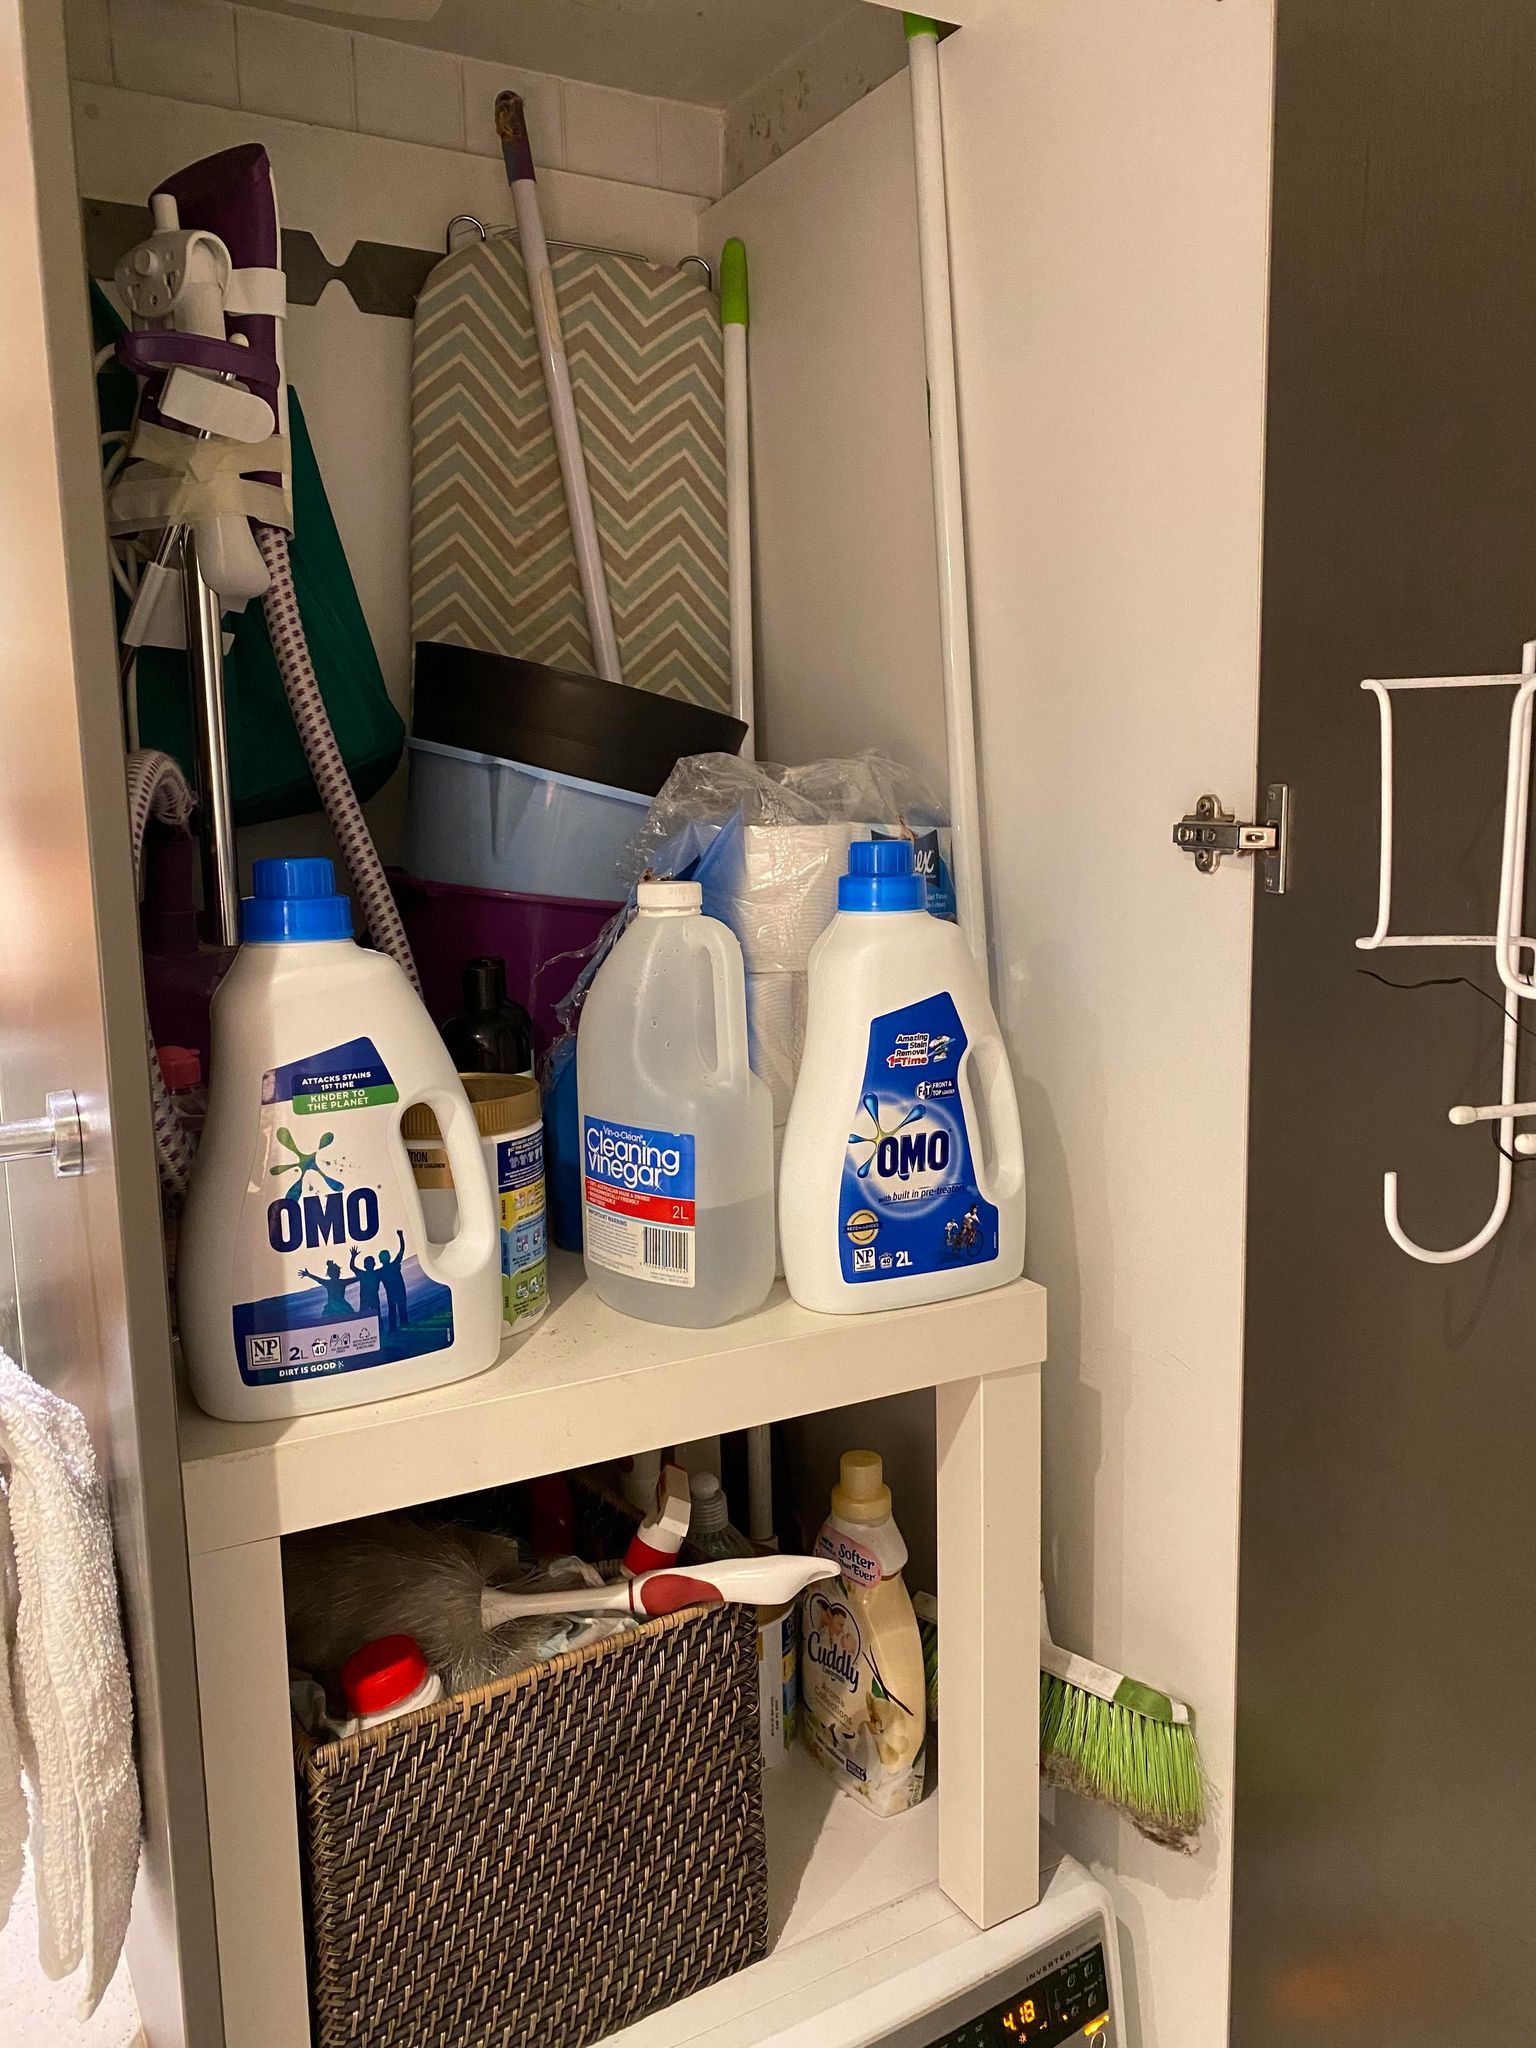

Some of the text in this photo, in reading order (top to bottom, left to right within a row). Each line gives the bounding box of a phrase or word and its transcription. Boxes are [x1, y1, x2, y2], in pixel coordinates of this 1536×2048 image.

[897, 1033, 928, 1043] Amazing
[909, 1041, 927, 1049] Stain
[896, 1048, 926, 1057] Removal
[301, 1071, 371, 1086] ATTACKS STAINS
[335, 1080, 354, 1089] TIME
[307, 1096, 369, 1111] THE PLANET
[310, 1089, 365, 1103] KINDER TO
[587, 1128, 680, 1176] Cleaning
[877, 1130, 949, 1178] OMO
[588, 1151, 662, 1189] vinegar
[893, 1190, 910, 1201] built
[911, 1190, 919, 1199] in
[267, 1187, 380, 1253] OMO
[672, 1205, 689, 1220] 2L
[856, 1249, 874, 1265] NP
[882, 1257, 891, 1265] 40
[896, 1251, 913, 1267] 2L
[253, 1339, 279, 1357] NP
[289, 1346, 309, 1361] 2L
[314, 1344, 325, 1354] 40
[279, 1362, 337, 1377] DIRT IS GOOD
[838, 1543, 875, 1570] Softer
[852, 1564, 876, 1582] Ever
[807, 1631, 859, 1693] Cuddly
[821, 1681, 845, 1707] Aroma
[814, 1685, 852, 1726] Collections
[1025, 1950, 1072, 1983] INVERTER
